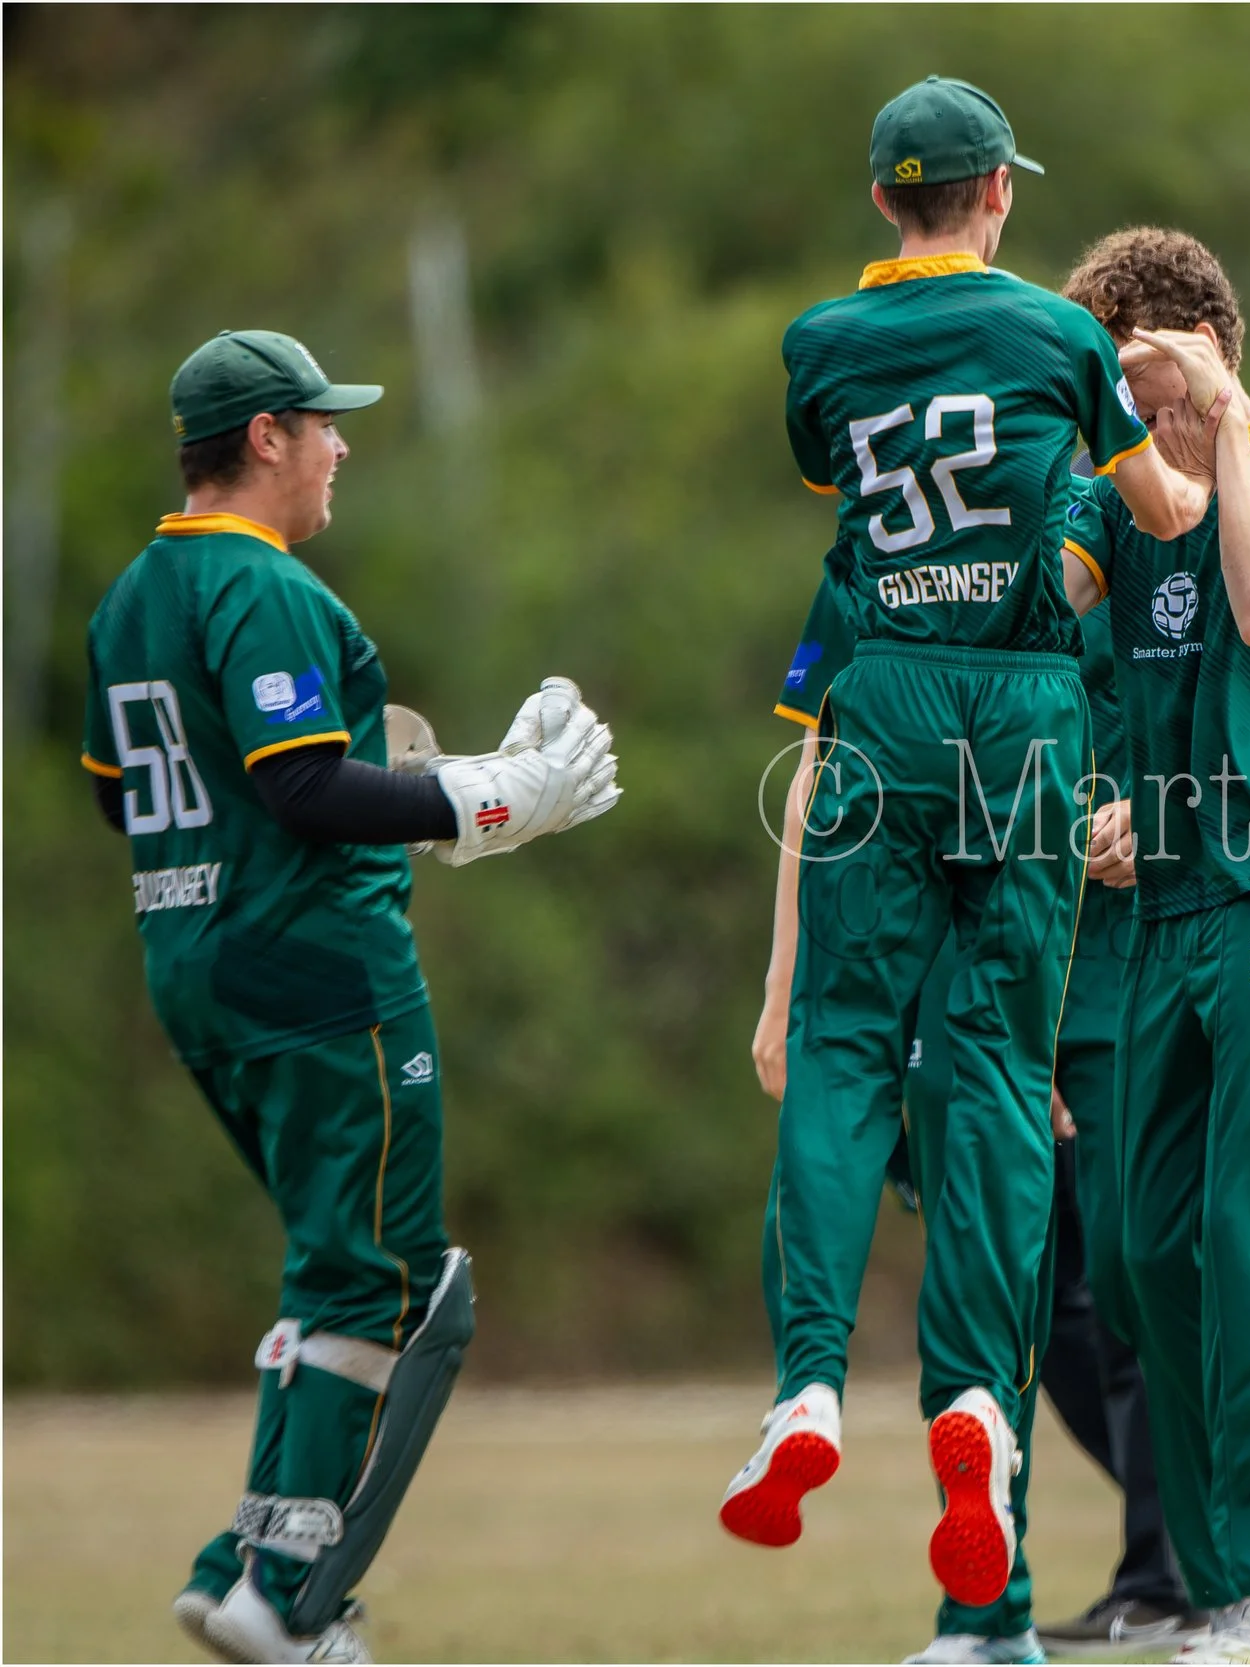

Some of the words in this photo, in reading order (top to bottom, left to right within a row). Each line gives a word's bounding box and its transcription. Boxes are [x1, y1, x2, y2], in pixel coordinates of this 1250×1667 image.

[849, 393, 1012, 553] 52
[877, 561, 1020, 609] GUERNSEY
[1132, 646, 1177, 659] Smarter
[107, 679, 214, 836] 58
